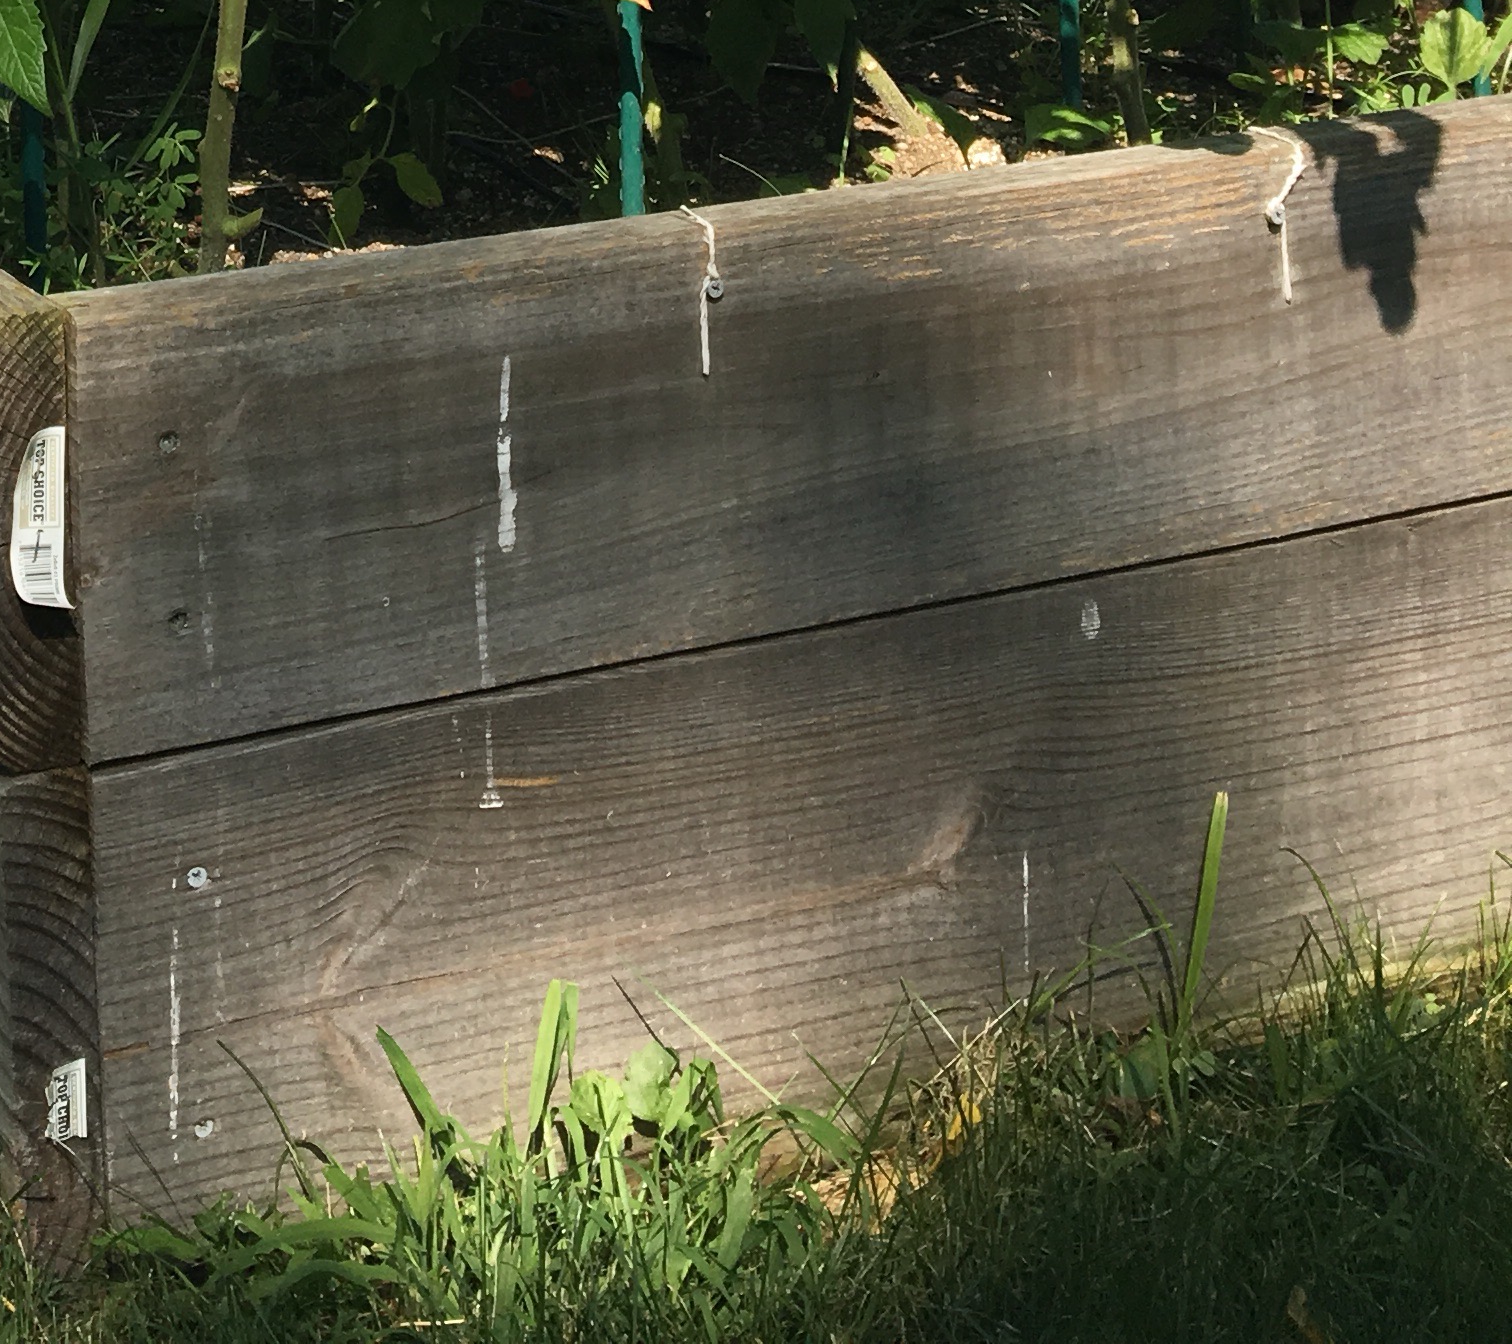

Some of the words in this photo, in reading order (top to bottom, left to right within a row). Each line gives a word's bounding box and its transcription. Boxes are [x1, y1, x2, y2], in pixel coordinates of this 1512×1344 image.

[35, 439, 46, 466] TOP
[32, 470, 45, 522] CHOICE
[57, 1074, 69, 1102] TOP
